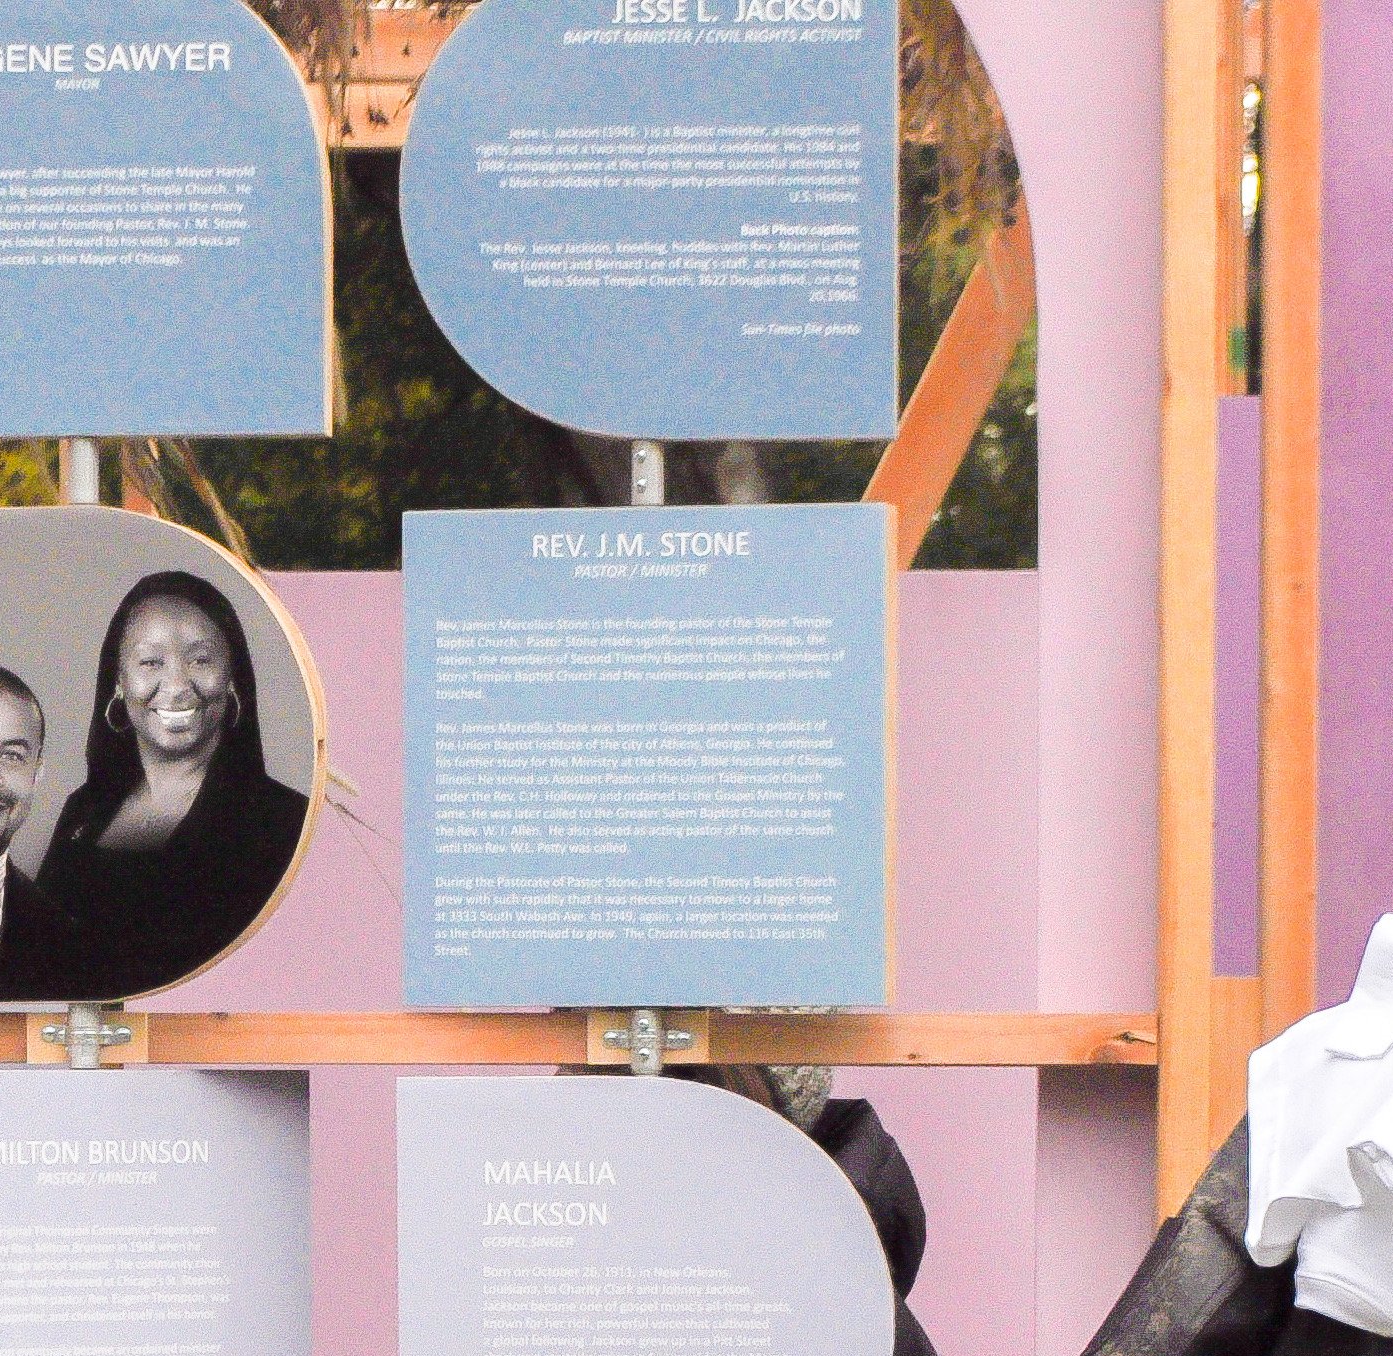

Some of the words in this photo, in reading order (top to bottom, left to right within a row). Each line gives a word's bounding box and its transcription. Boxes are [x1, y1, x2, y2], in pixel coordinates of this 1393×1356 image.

[612, 0, 687, 24] JESSE
[697, 0, 719, 23] L.
[734, 0, 862, 22] JACKSON
[563, 28, 621, 45] BAPTIST
[623, 28, 693, 44] MINISTER
[705, 28, 741, 44] CIVIL
[744, 27, 797, 43] RIGHTS
[798, 27, 863, 43] ACTIVIST
[84, 42, 231, 74] SAWYER
[54, 79, 101, 91] MAYOR
[532, 533, 588, 558] REV.
[596, 533, 651, 558] J.M.
[660, 531, 750, 557] STONE
[574, 563, 628, 579] PASTOR
[640, 563, 709, 578] MINISTER
[88, 1139, 209, 1165] BRUNSON
[36, 1171, 86, 1186] PASTOR
[97, 1171, 158, 1184] MINISTER
[484, 1160, 616, 1185] MAHALIA
[482, 1201, 608, 1226] JACKSON
[482, 1235, 528, 1248] GOSPEL
[530, 1236, 575, 1249] SINGER
